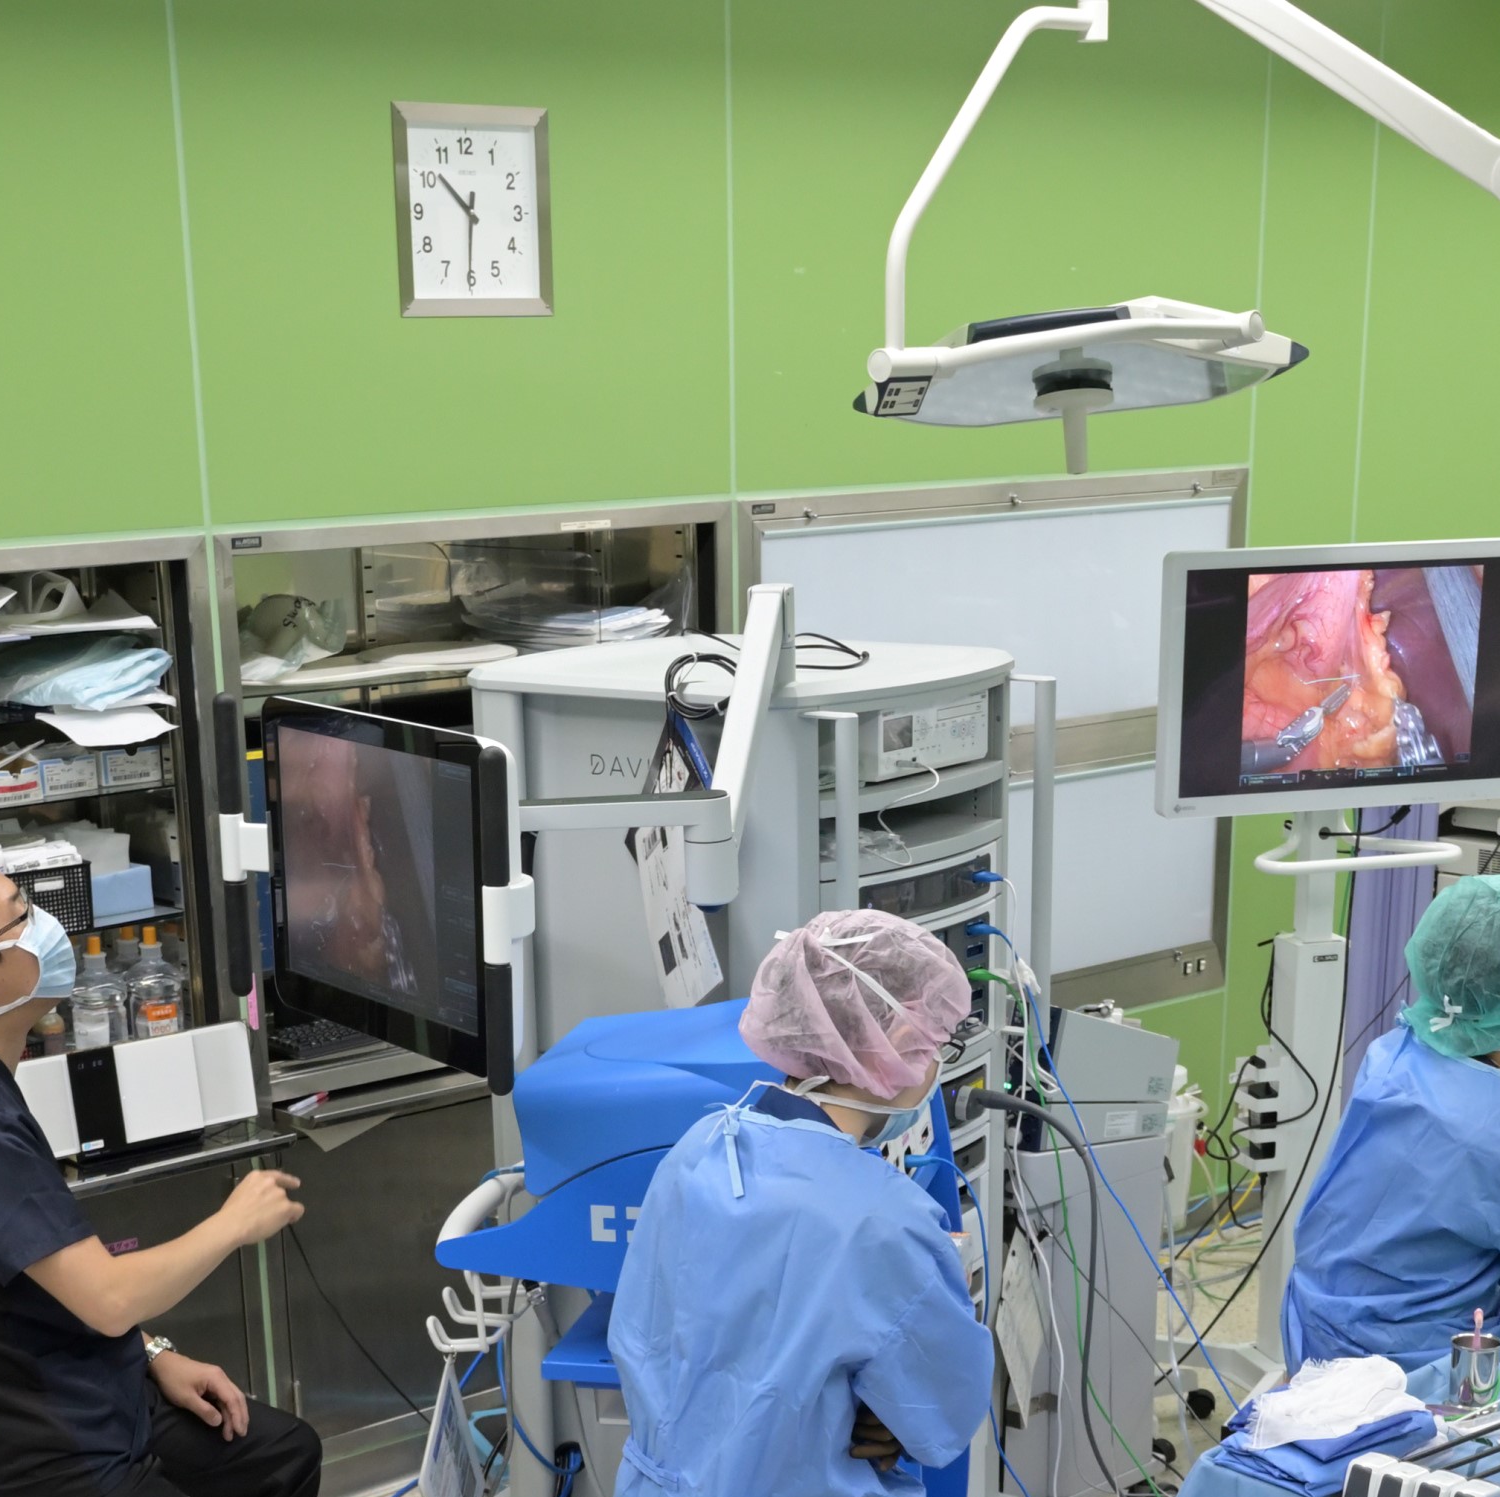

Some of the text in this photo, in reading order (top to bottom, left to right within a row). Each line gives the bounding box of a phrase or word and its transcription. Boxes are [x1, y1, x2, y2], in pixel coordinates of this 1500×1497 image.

[456, 138, 473, 155] 12
[435, 147, 449, 164] 11
[488, 148, 495, 166] 1
[419, 170, 437, 188] 10
[506, 173, 516, 190] 2
[414, 203, 424, 220] 9
[513, 205, 523, 222] 3
[422, 236, 433, 253] 8
[507, 237, 516, 254] 4
[440, 260, 451, 278] 7
[491, 261, 500, 278] 5
[467, 269, 476, 287] 6
